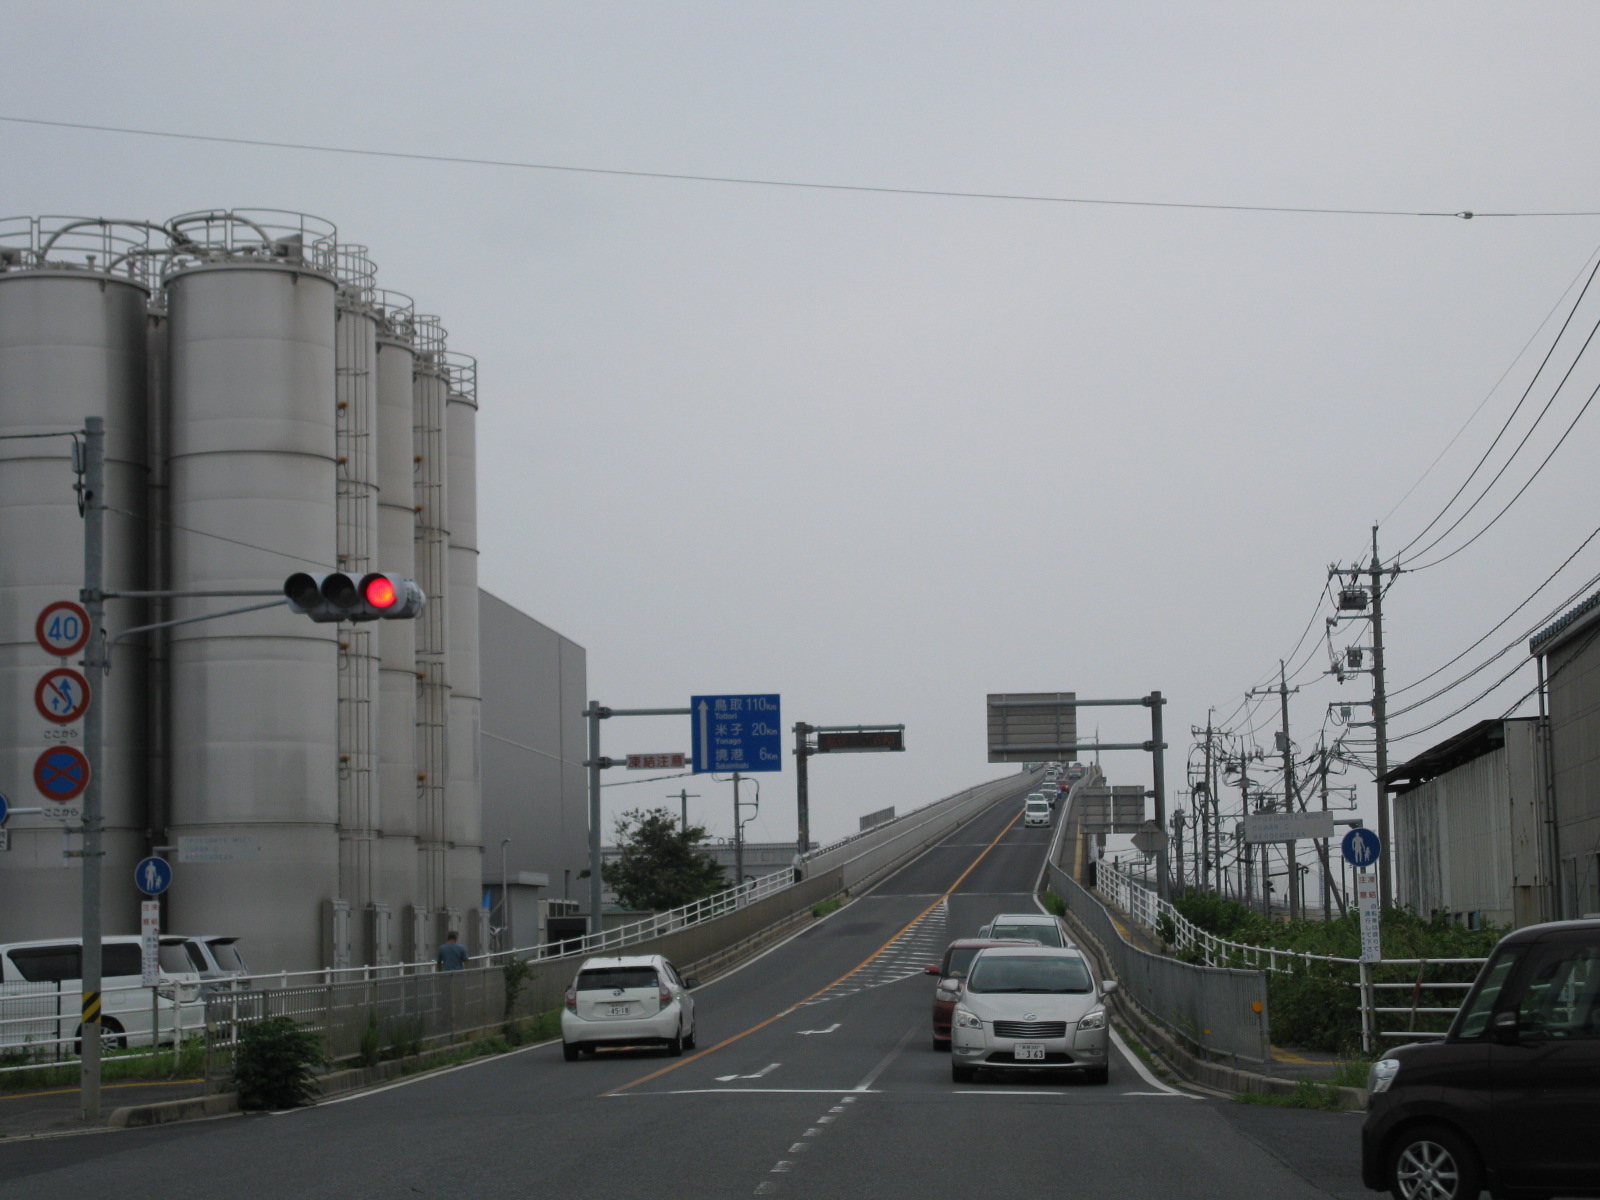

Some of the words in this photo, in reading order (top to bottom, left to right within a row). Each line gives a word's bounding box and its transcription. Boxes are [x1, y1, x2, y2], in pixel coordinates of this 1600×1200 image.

[48, 616, 78, 640] 40
[715, 699, 743, 711] 鳥取
[44, 729, 78, 739] ここから
[715, 723, 743, 736] 米子
[715, 738, 741, 746] Yonago
[716, 748, 744, 761] 境港
[628, 755, 684, 768] 凍結注意
[44, 808, 79, 817] ここから
